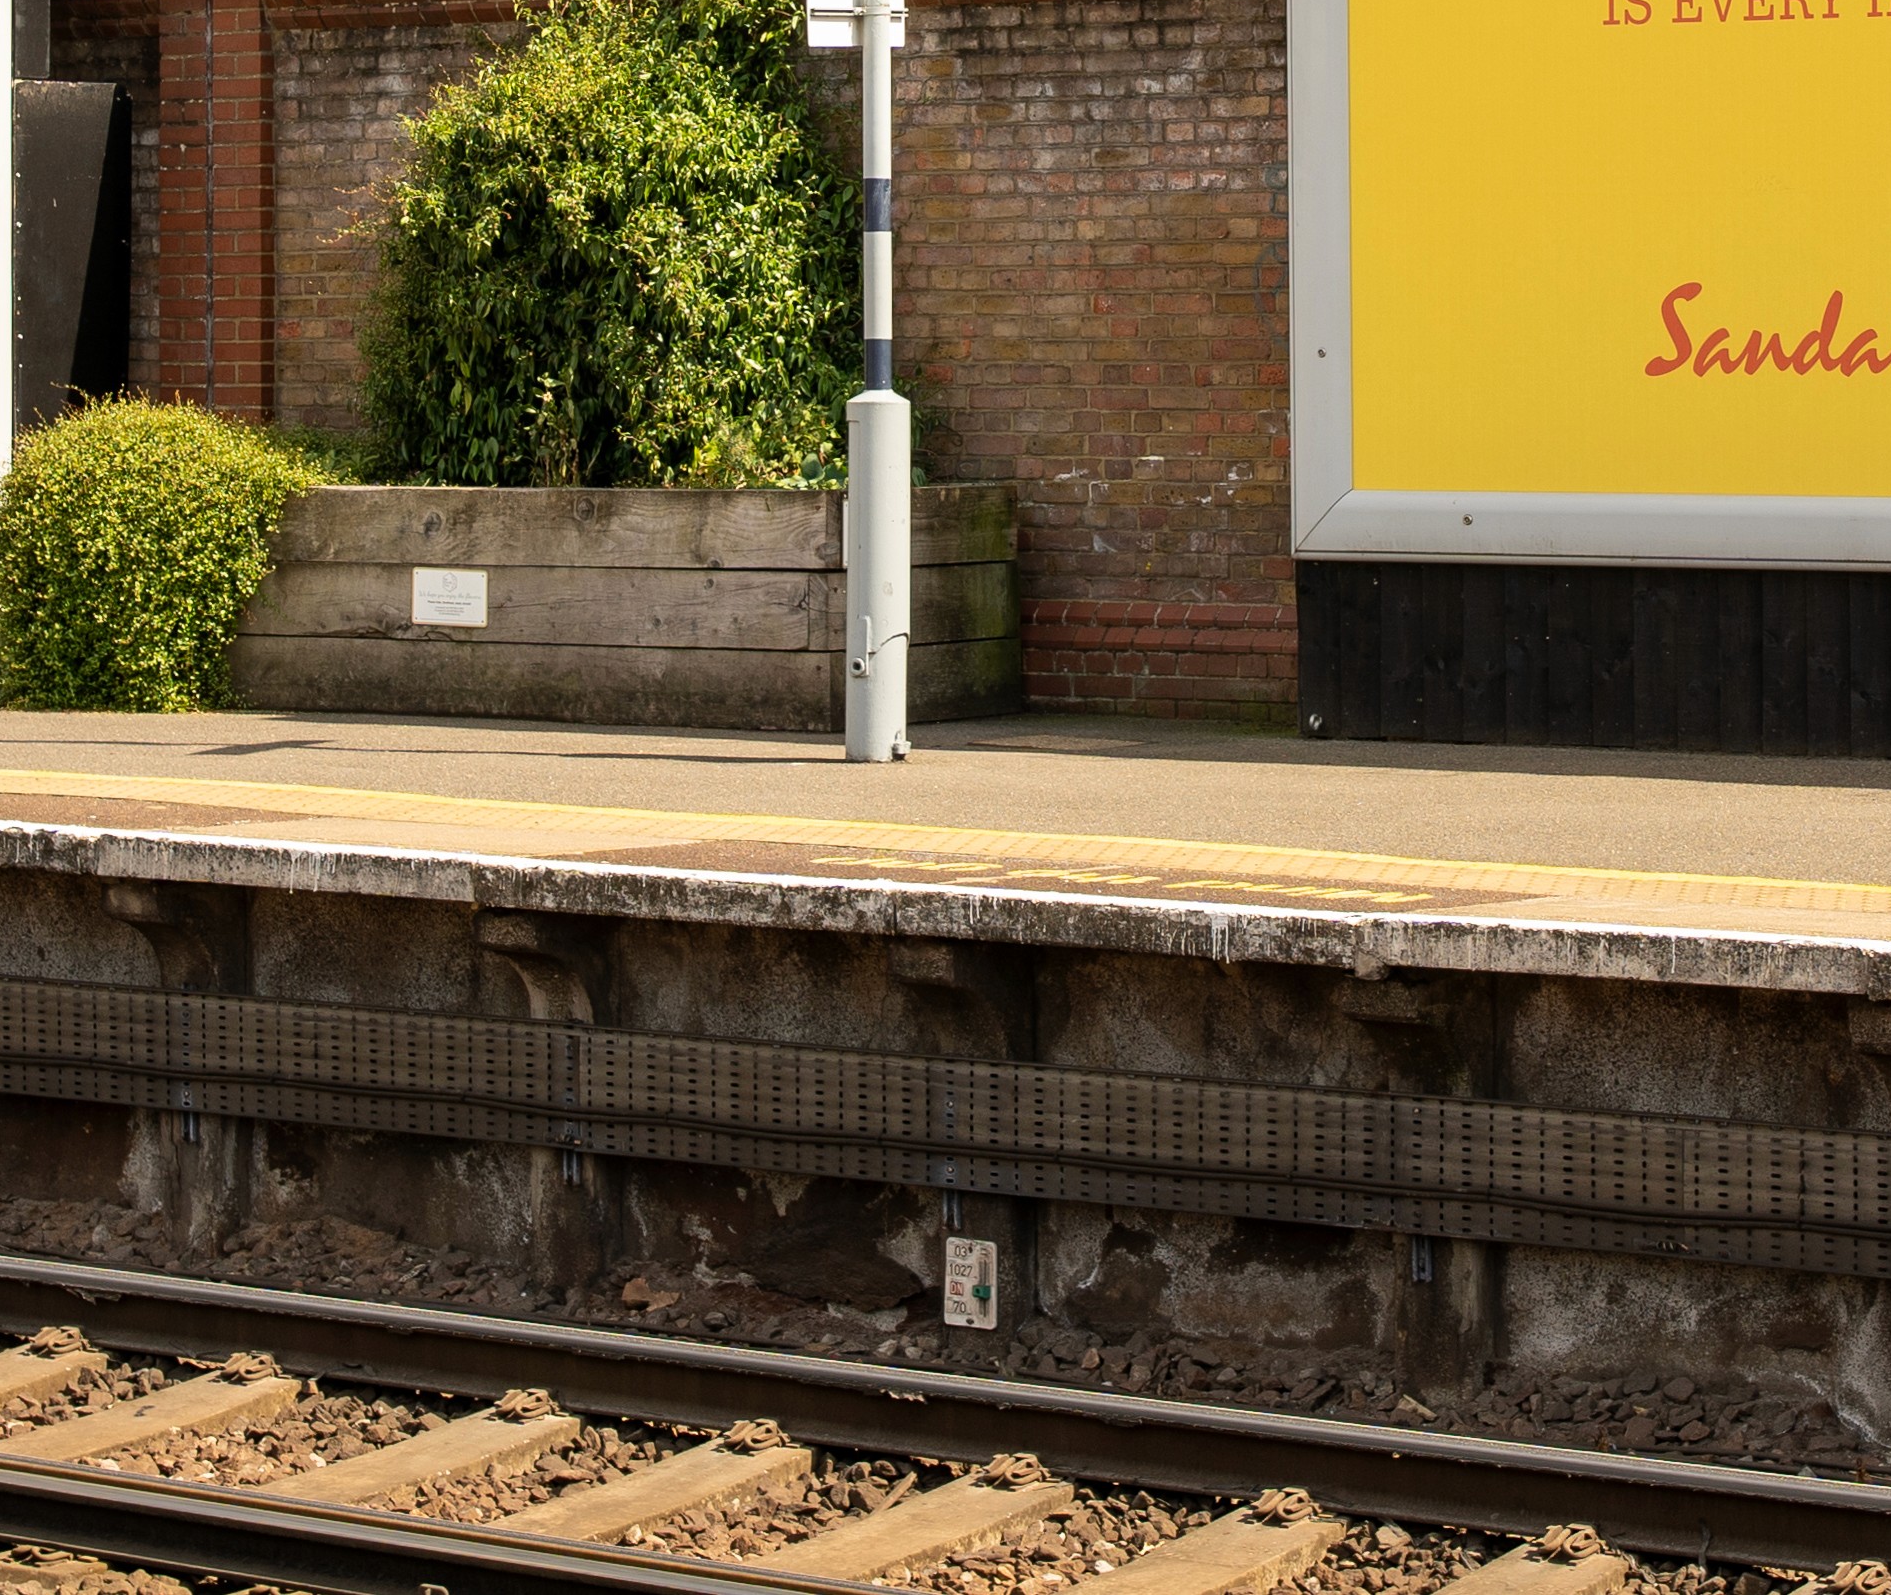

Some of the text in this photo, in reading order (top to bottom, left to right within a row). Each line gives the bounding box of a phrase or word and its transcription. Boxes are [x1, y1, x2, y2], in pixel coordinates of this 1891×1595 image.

[954, 1245, 968, 1258] 03
[949, 1263, 973, 1278] 1027
[952, 1300, 967, 1314] 70
